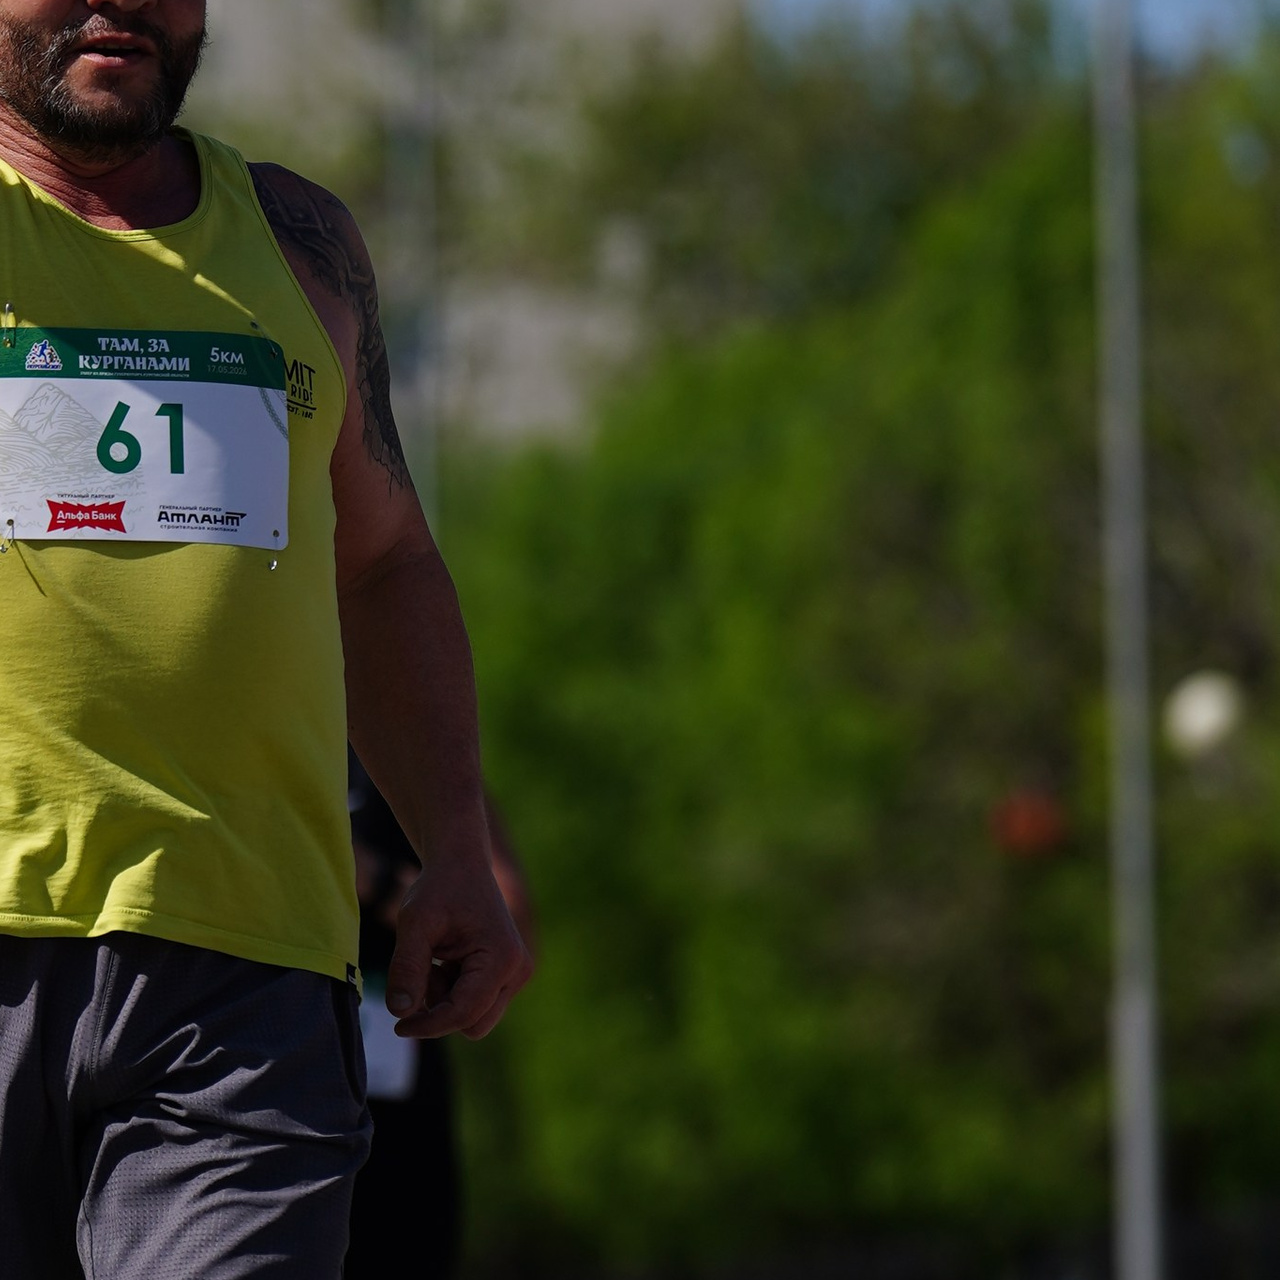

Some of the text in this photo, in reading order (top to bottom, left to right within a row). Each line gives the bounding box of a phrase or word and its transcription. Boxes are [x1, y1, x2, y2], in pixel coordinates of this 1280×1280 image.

[98, 338, 170, 355] ТАМ, ЗА
[79, 355, 190, 371] КУРГАНАМИ
[97, 401, 185, 474] 61
[56, 510, 117, 523] Альфа Банк
